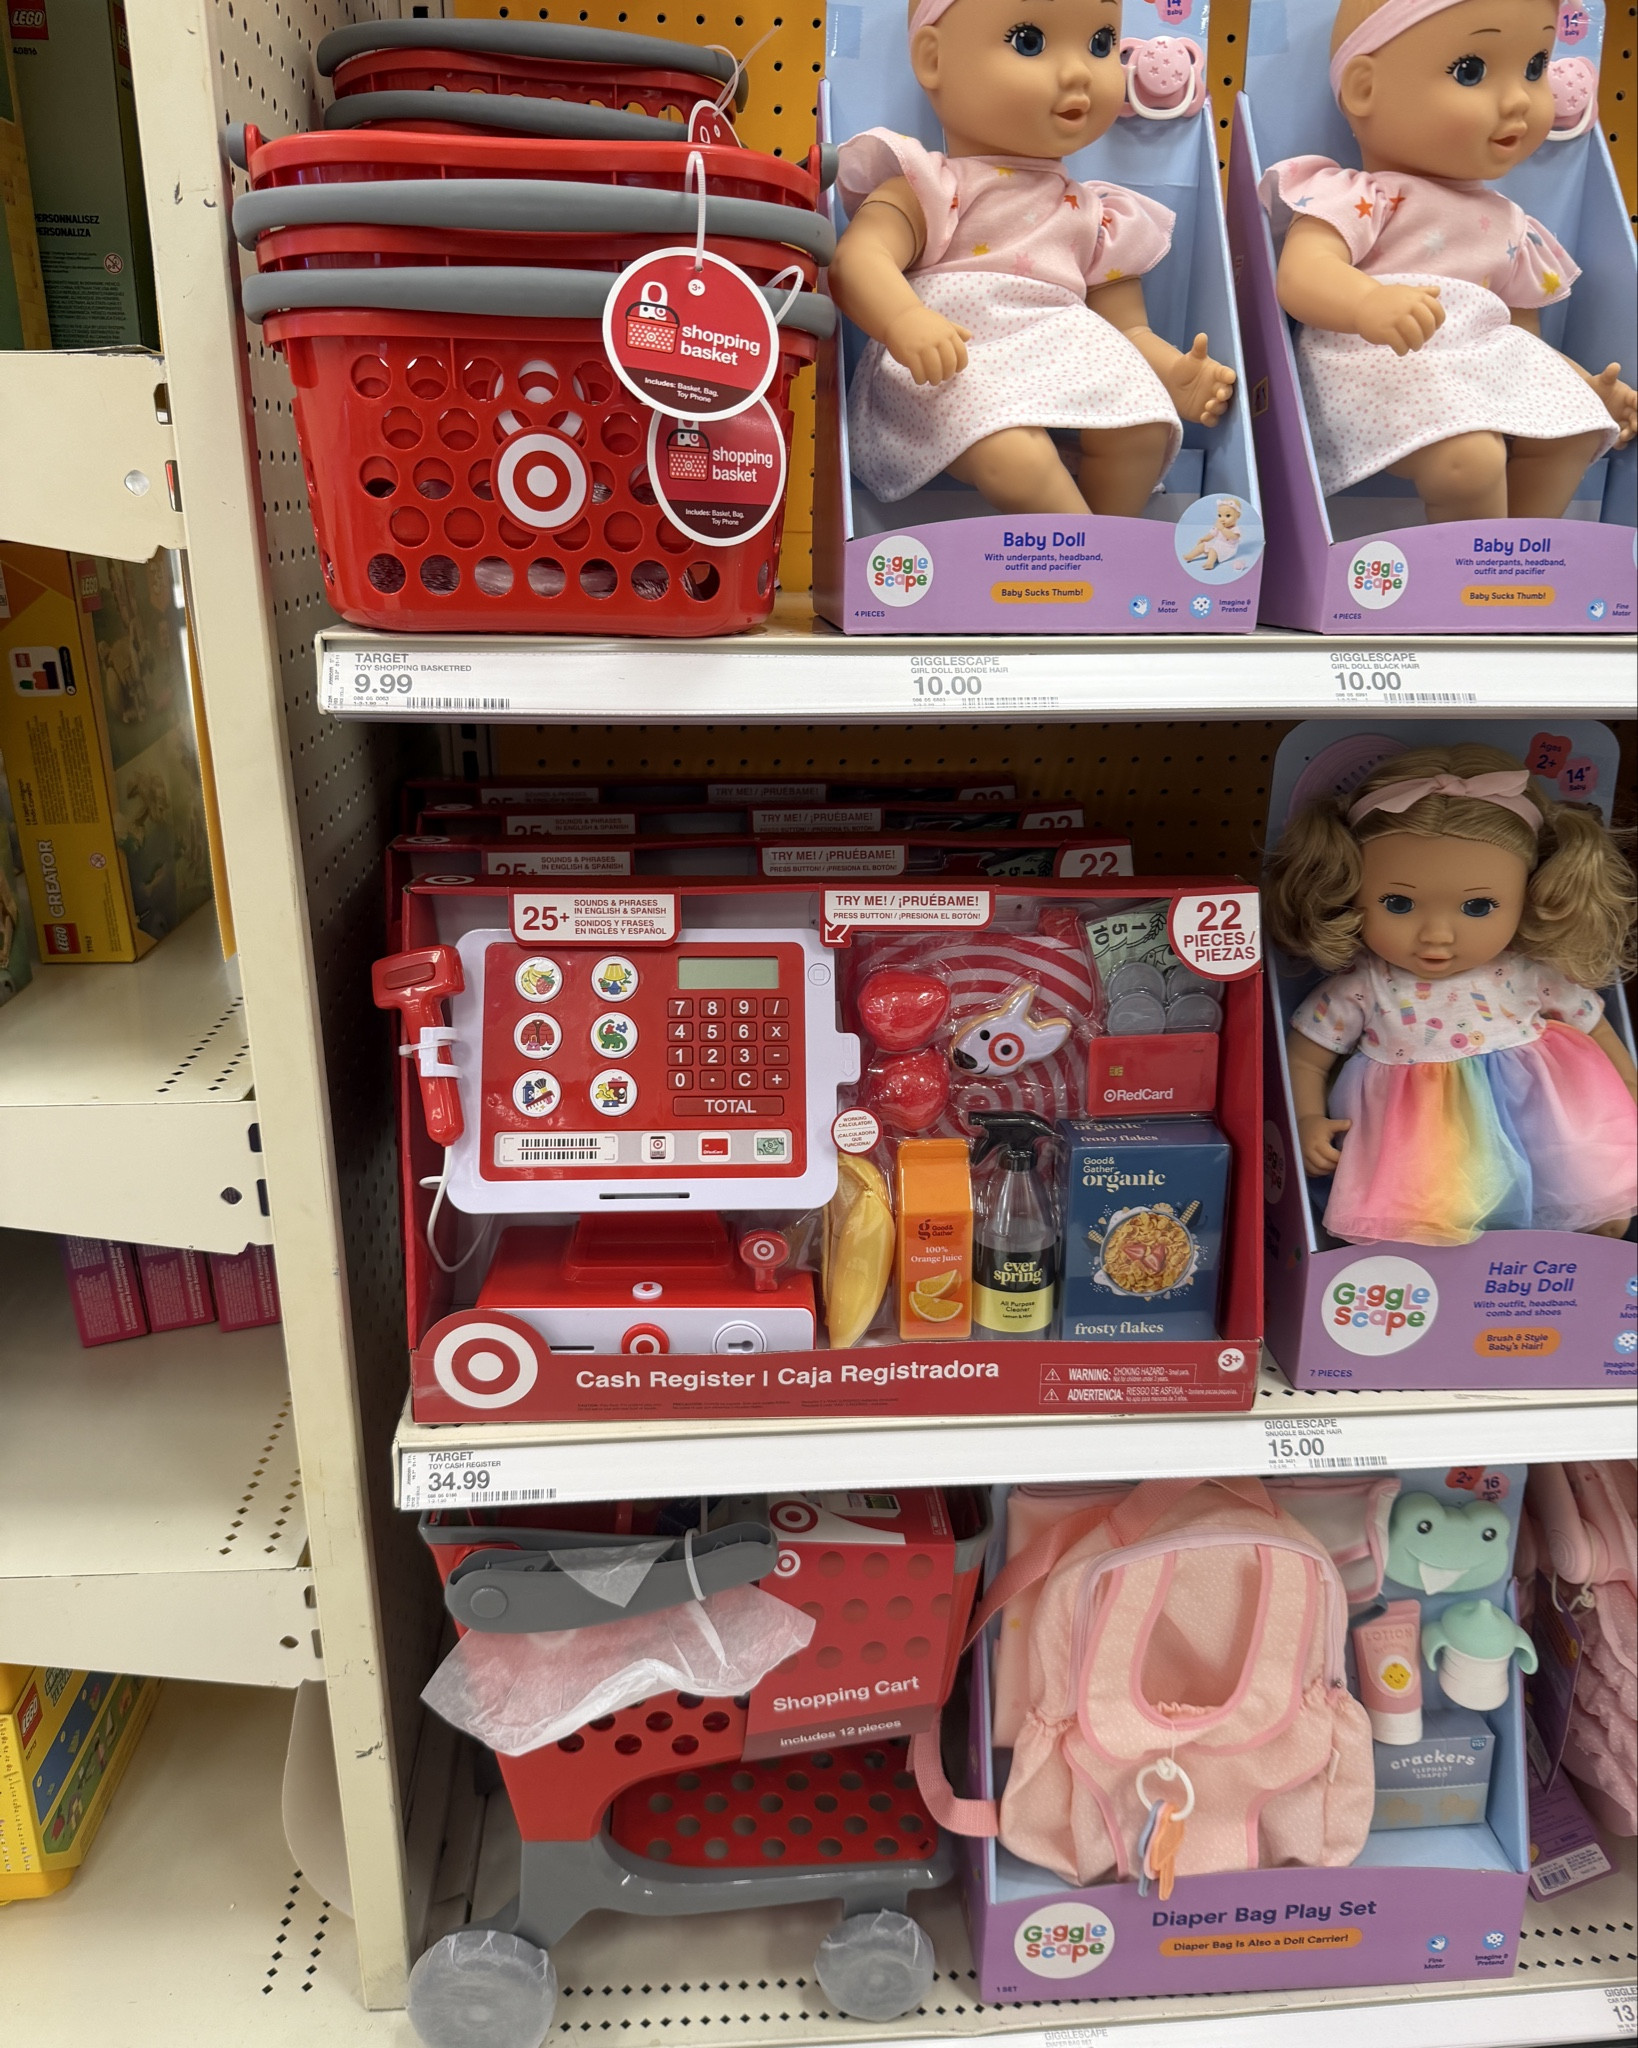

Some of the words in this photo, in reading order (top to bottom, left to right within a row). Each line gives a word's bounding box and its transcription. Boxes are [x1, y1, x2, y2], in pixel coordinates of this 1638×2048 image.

[12, 10, 45, 27] LEGO
[682, 325, 760, 356] shopping
[680, 340, 738, 366] basket
[712, 447, 773, 469] shopping
[712, 465, 757, 482] basket
[1004, 532, 1047, 551] Baby
[1053, 532, 1085, 547] Doll
[1474, 538, 1514, 556] Baby
[1520, 538, 1551, 552] Doll
[1006, 563, 1029, 571] outfit
[1031, 563, 1047, 571] and
[1050, 563, 1081, 572] pacifier
[82, 576, 98, 596] LEGO
[1002, 589, 1022, 598] Baby
[1470, 592, 1489, 601] Baby
[1492, 592, 1514, 600] Sucks
[355, 654, 409, 663] TARGET
[910, 657, 999, 666] GIGGLESCAPE
[1330, 653, 1416, 662] GIGGLESCAPE
[355, 674, 412, 694] 9.99
[914, 676, 982, 695] 10.00
[1335, 672, 1401, 690] 10.00
[1540, 742, 1562, 752] Ages
[1537, 755, 1556, 769] 2+
[772, 852, 793, 861] TRY
[826, 849, 895, 862] ¡PRUÉBAME!
[38, 840, 65, 918] CREATOR
[574, 899, 608, 907] SOUNDS
[619, 899, 658, 907] PHRASES
[836, 896, 861, 906] TRY
[864, 896, 887, 906] ME!
[899, 893, 979, 908] ¡PRUÉBAME!
[586, 907, 620, 915] ENGLISH
[631, 907, 666, 915] SPANISH
[952, 911, 981, 919] BOTÓN!
[1197, 900, 1242, 932] 22
[523, 906, 570, 931] 25+
[587, 926, 618, 935] INGLÉS
[628, 925, 666, 935] ESPAÑOL
[55, 926, 70, 953] LEGO
[1184, 932, 1246, 948] PIECES
[1195, 946, 1256, 963] PIEZAS
[675, 1001, 685, 1015] 7
[708, 1001, 717, 1015] 8
[739, 1000, 749, 1015] 9
[675, 1025, 685, 1038] 4
[707, 1025, 718, 1039] 5
[739, 1025, 749, 1038] 6
[708, 1049, 718, 1063] 2
[740, 1049, 750, 1063] 3
[1117, 1088, 1174, 1100] RedCard
[705, 1100, 756, 1113] TOTAL
[1084, 1157, 1115, 1165] Good&
[1083, 1165, 1115, 1173] Gather
[1082, 1170, 1165, 1192] organic
[911, 1255, 940, 1263] Orange
[1488, 1261, 1528, 1276] Hair
[1533, 1261, 1577, 1274] Care
[994, 1268, 1041, 1285] spring
[1485, 1280, 1531, 1296] Baby
[1538, 1278, 1575, 1293] Doll
[1075, 1323, 1117, 1336] frosty
[1120, 1322, 1164, 1334] flakes
[1525, 1334, 1548, 1342] Style
[1222, 1354, 1241, 1367] 3+
[576, 1370, 640, 1388] Cash
[651, 1370, 755, 1391] Register
[778, 1366, 832, 1388] Caja
[841, 1360, 999, 1385] Registradora
[1069, 1368, 1111, 1380] WARNING:
[1114, 1367, 1140, 1376] CHOKING
[1141, 1367, 1165, 1376] HAZARD
[1318, 1370, 1353, 1378] PIECES
[1068, 1389, 1123, 1401] ADVERTENCIA:
[1126, 1387, 1149, 1395] RIESGO
[1265, 1419, 1337, 1430] GIGGLESCAPE
[1269, 1438, 1325, 1457] 15.00
[429, 1452, 474, 1462] TARGET
[428, 1470, 491, 1491] 34.99
[1456, 1472, 1473, 1484] 2+
[1484, 1477, 1500, 1489] 16
[1366, 1629, 1412, 1641] LOTION
[773, 1687, 870, 1713] Shopping
[874, 1676, 920, 1695] Cart
[22, 1696, 40, 1733] LEGO
[780, 1730, 836, 1747] includes
[840, 1726, 855, 1737] 12
[858, 1720, 901, 1735] pieces
[1391, 1750, 1475, 1770] crackers
[1413, 1766, 1452, 1774] ELEPHANT
[1153, 1910, 1227, 1929] Diaper
[1236, 1907, 1276, 1924] Bag
[1285, 1904, 1331, 1921] Play
[1339, 1901, 1377, 1916] Set
[1174, 1942, 1209, 1952] Diaper
[1212, 1941, 1233, 1950] Bag
[1248, 1939, 1271, 1947] Also
[1284, 1937, 1305, 1945] Doll
[1307, 1934, 1349, 1944] Carrier!
[1045, 2029, 1108, 2040] GIGGLESCAPE
